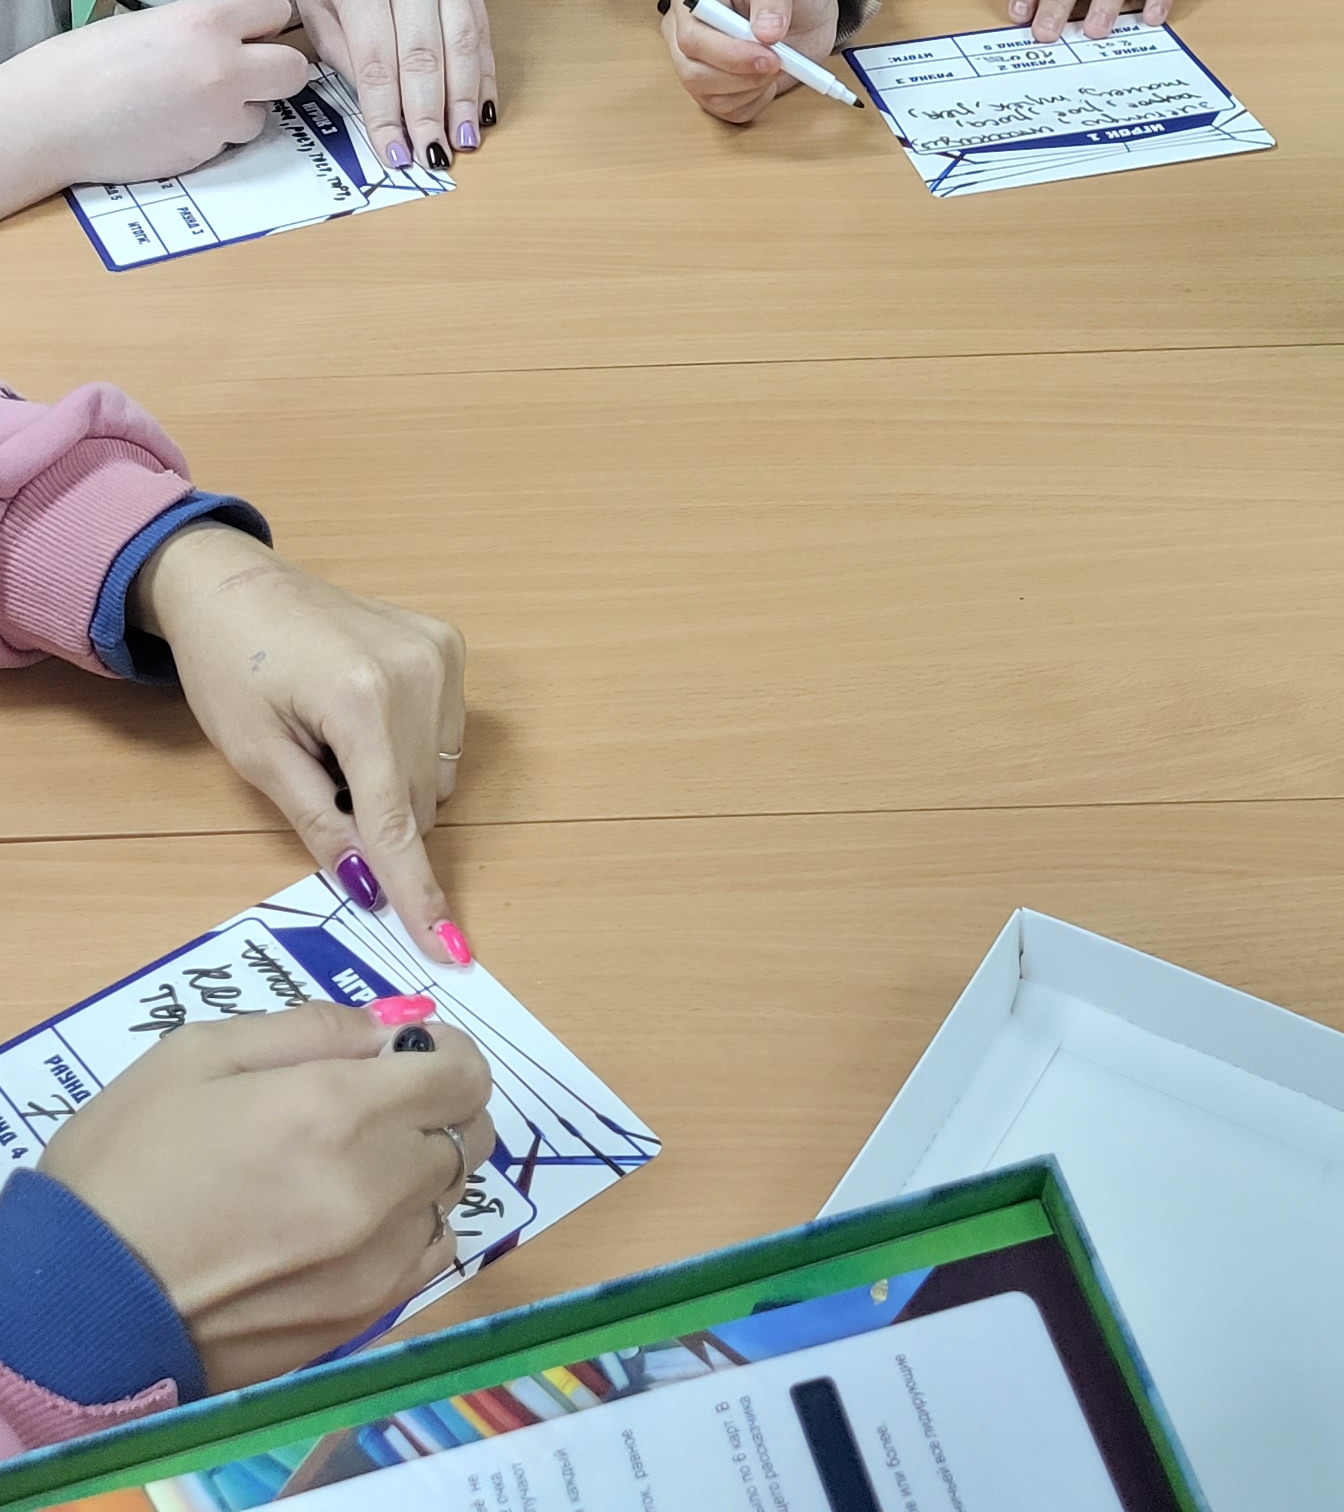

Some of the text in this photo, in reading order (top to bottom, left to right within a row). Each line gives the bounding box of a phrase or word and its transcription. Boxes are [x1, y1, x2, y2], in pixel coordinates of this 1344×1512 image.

[888, 52, 934, 63] ИТОГИ:
[1114, 45, 1158, 55] РАУНД
[1012, 57, 1057, 70] РАУНД
[909, 72, 955, 82] РАУНД
[301, 101, 338, 136] ИГРОК 3
[1086, 123, 1165, 143] ИГРОК 1
[177, 206, 198, 229] РАУНД
[127, 221, 150, 246] ИТОГИ:
[43, 1054, 92, 1105] РАУНД
[11, 1146, 29, 1160] 4
[894, 1352, 937, 1440] лидирующие
[715, 1400, 730, 1414] В
[739, 1394, 780, 1480] рассказчика
[622, 1428, 649, 1480] равное
[732, 1452, 747, 1463] 6
[739, 1464, 754, 1484] по
[894, 1469, 911, 1499] или
